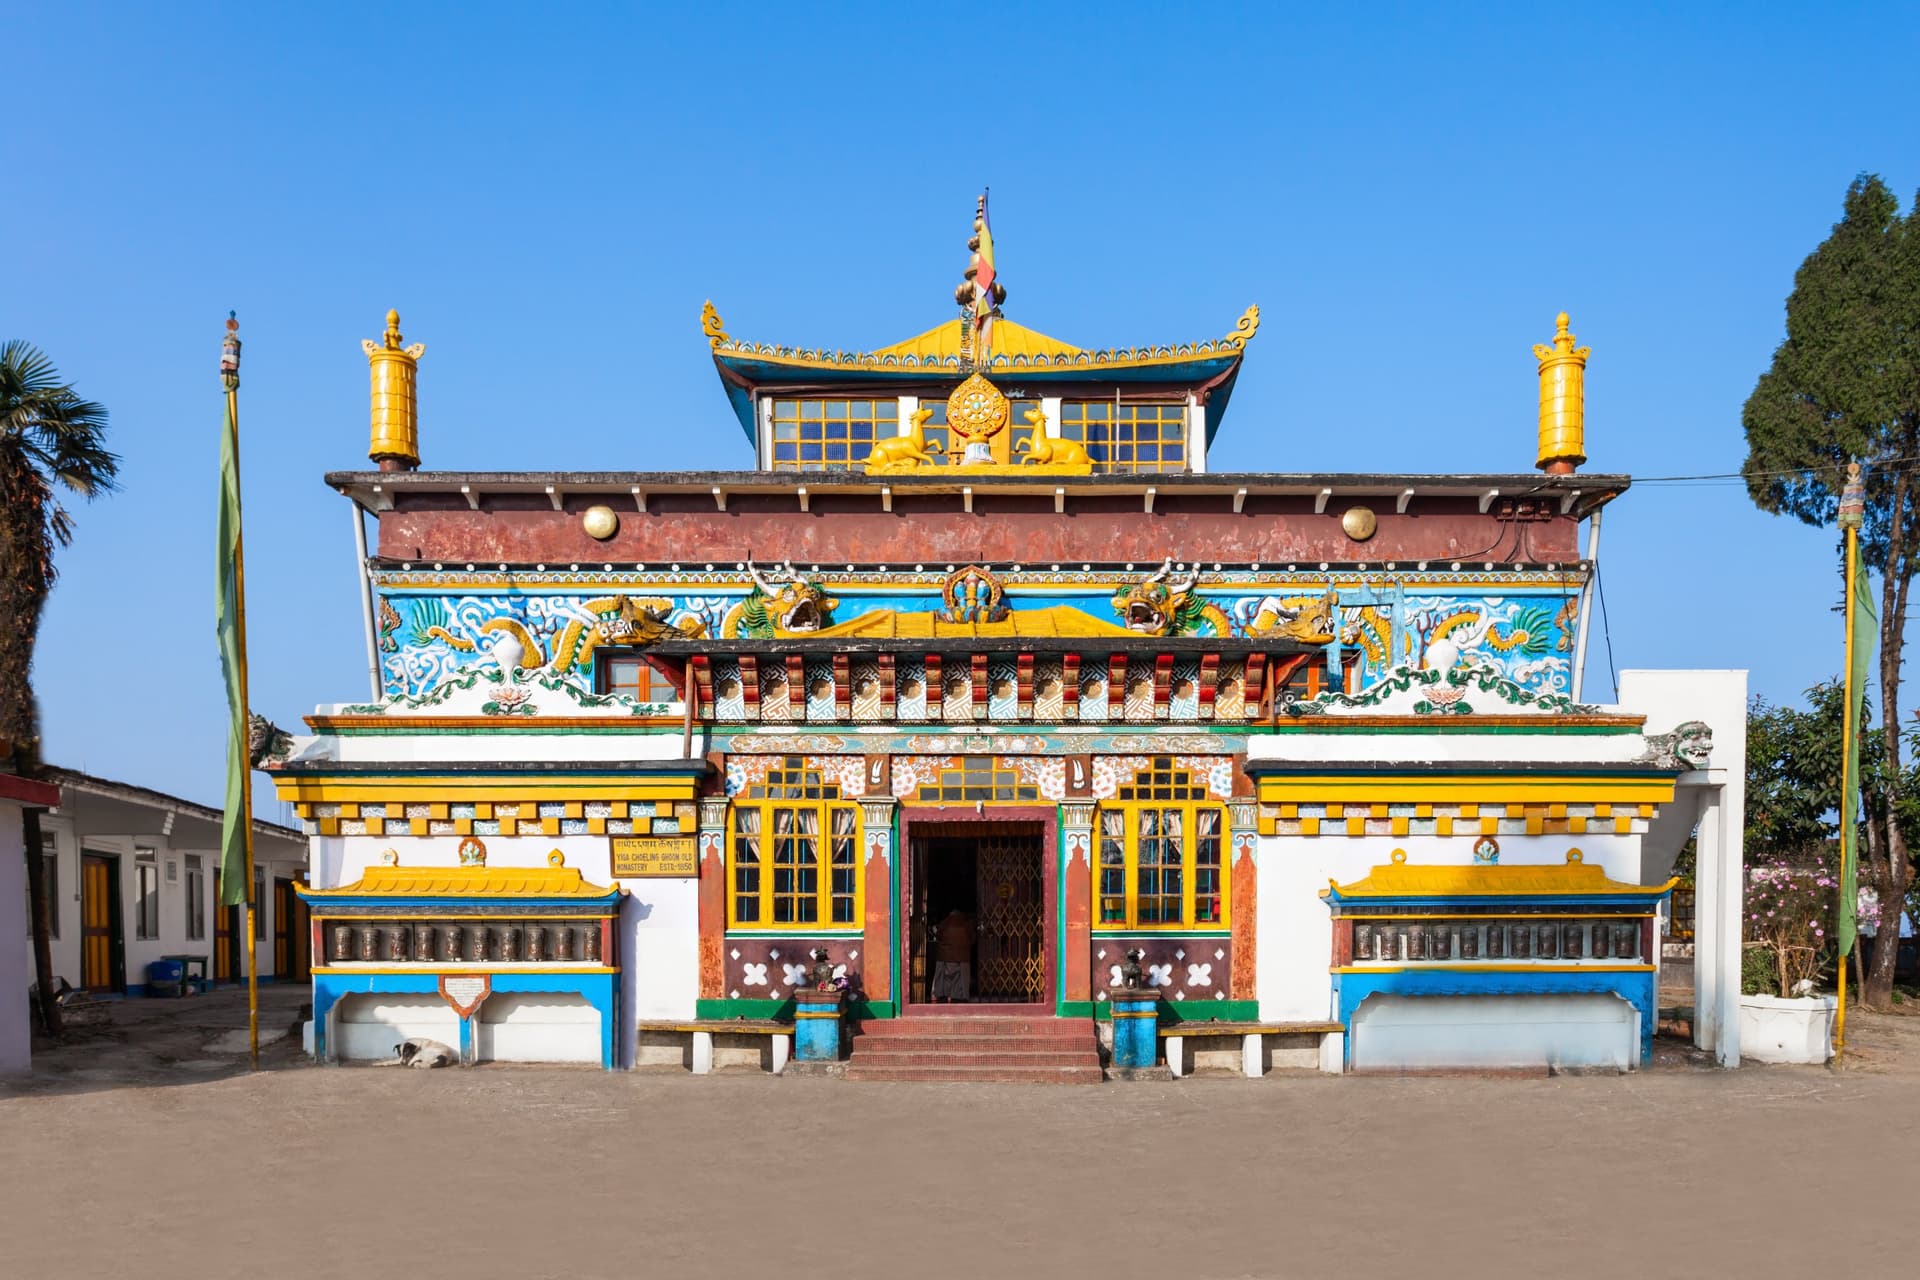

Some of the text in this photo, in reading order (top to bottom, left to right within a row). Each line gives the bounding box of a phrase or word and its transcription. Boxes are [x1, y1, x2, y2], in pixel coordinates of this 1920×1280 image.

[616, 853, 692, 861] YIGA CHOELING GHOOM OLD
[617, 863, 648, 871] MONASTERY
